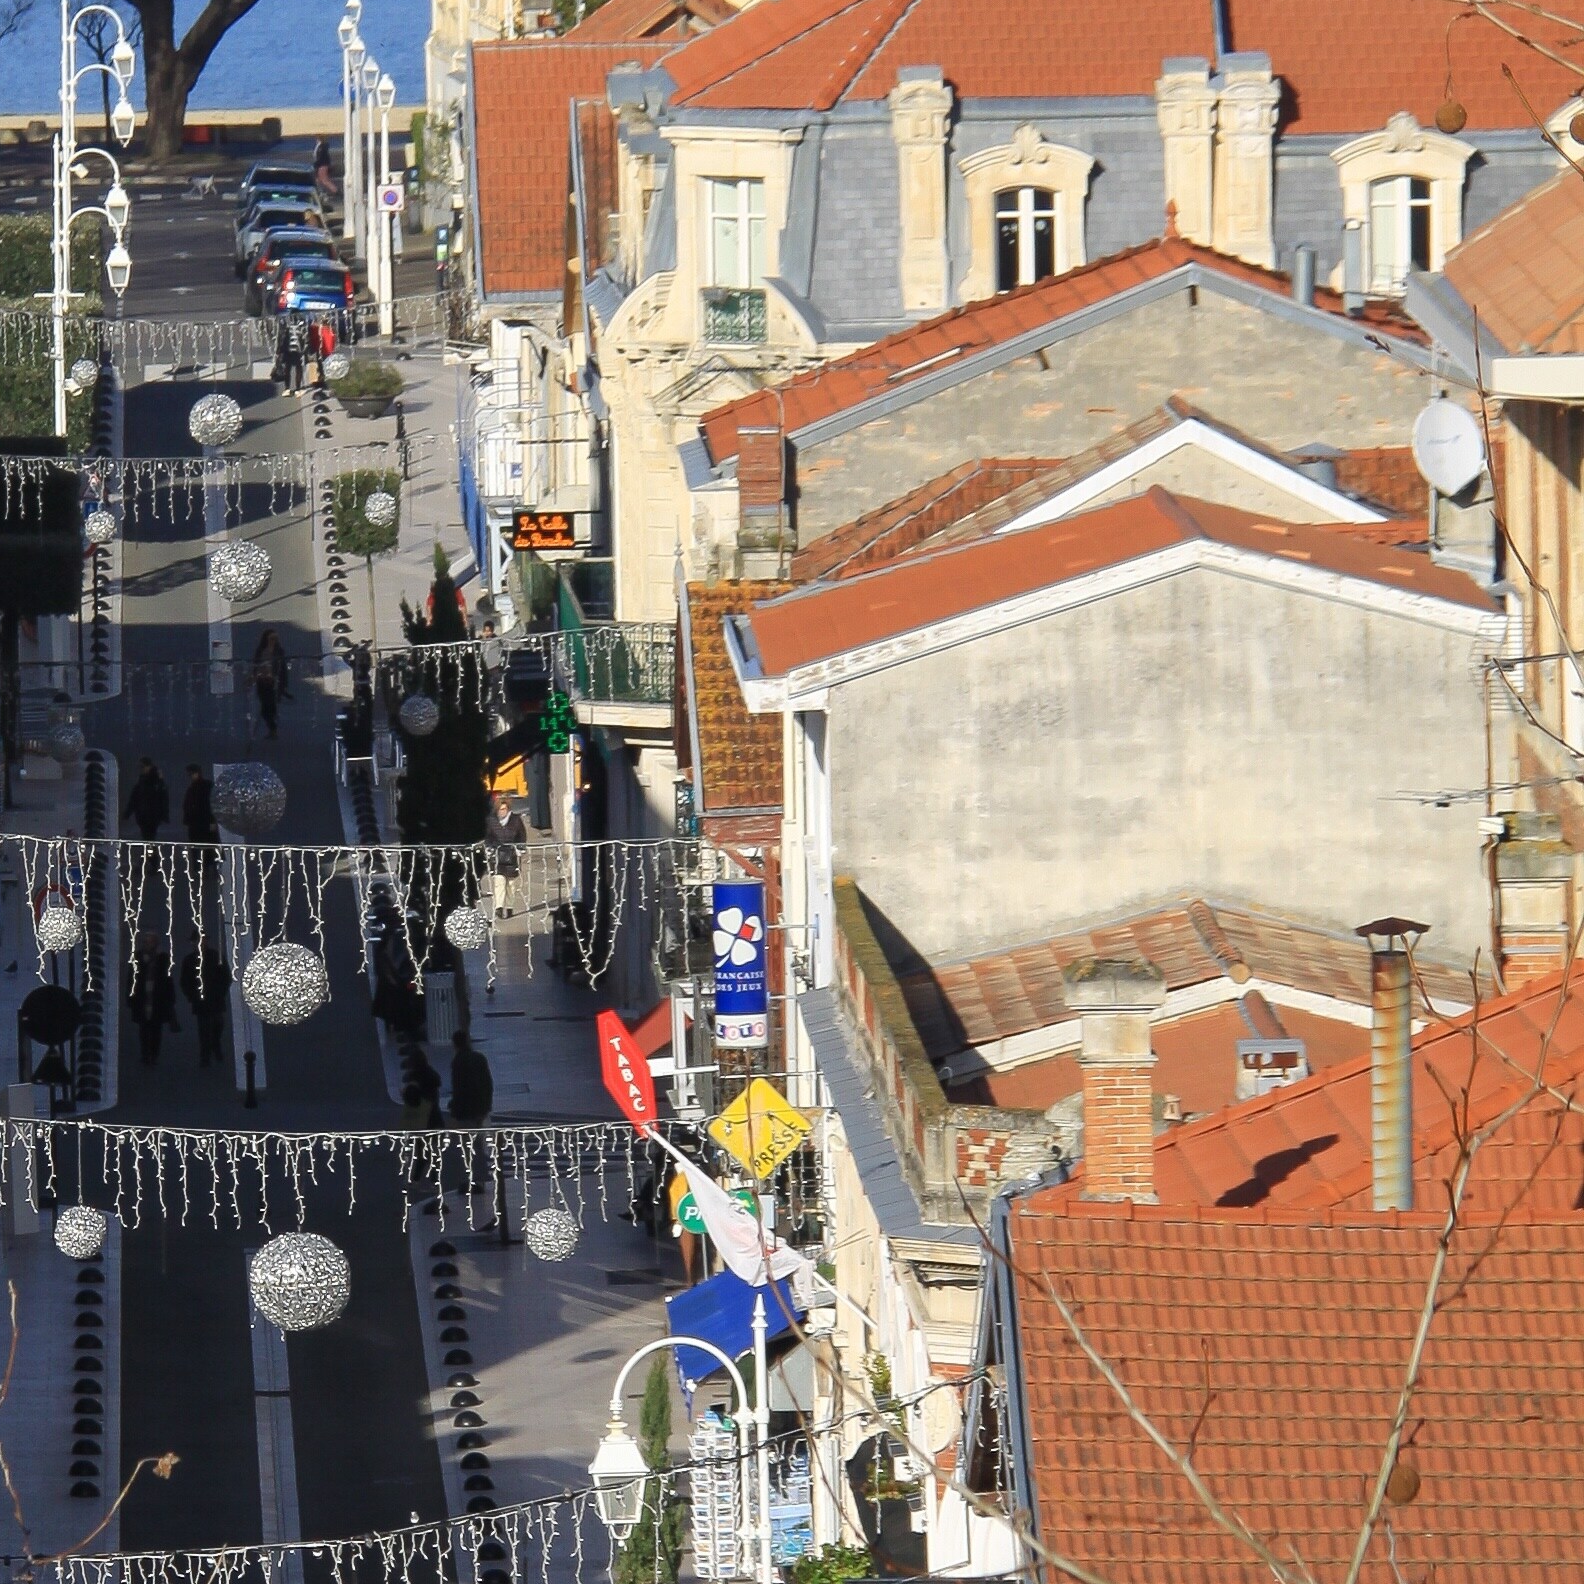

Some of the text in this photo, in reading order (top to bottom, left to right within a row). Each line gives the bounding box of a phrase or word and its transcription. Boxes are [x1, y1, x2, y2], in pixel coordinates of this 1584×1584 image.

[736, 982, 763, 993] JEUX
[715, 1021, 766, 1040] LOTO
[609, 1036, 646, 1113] TABAC
[753, 1120, 808, 1172] PRESSE
